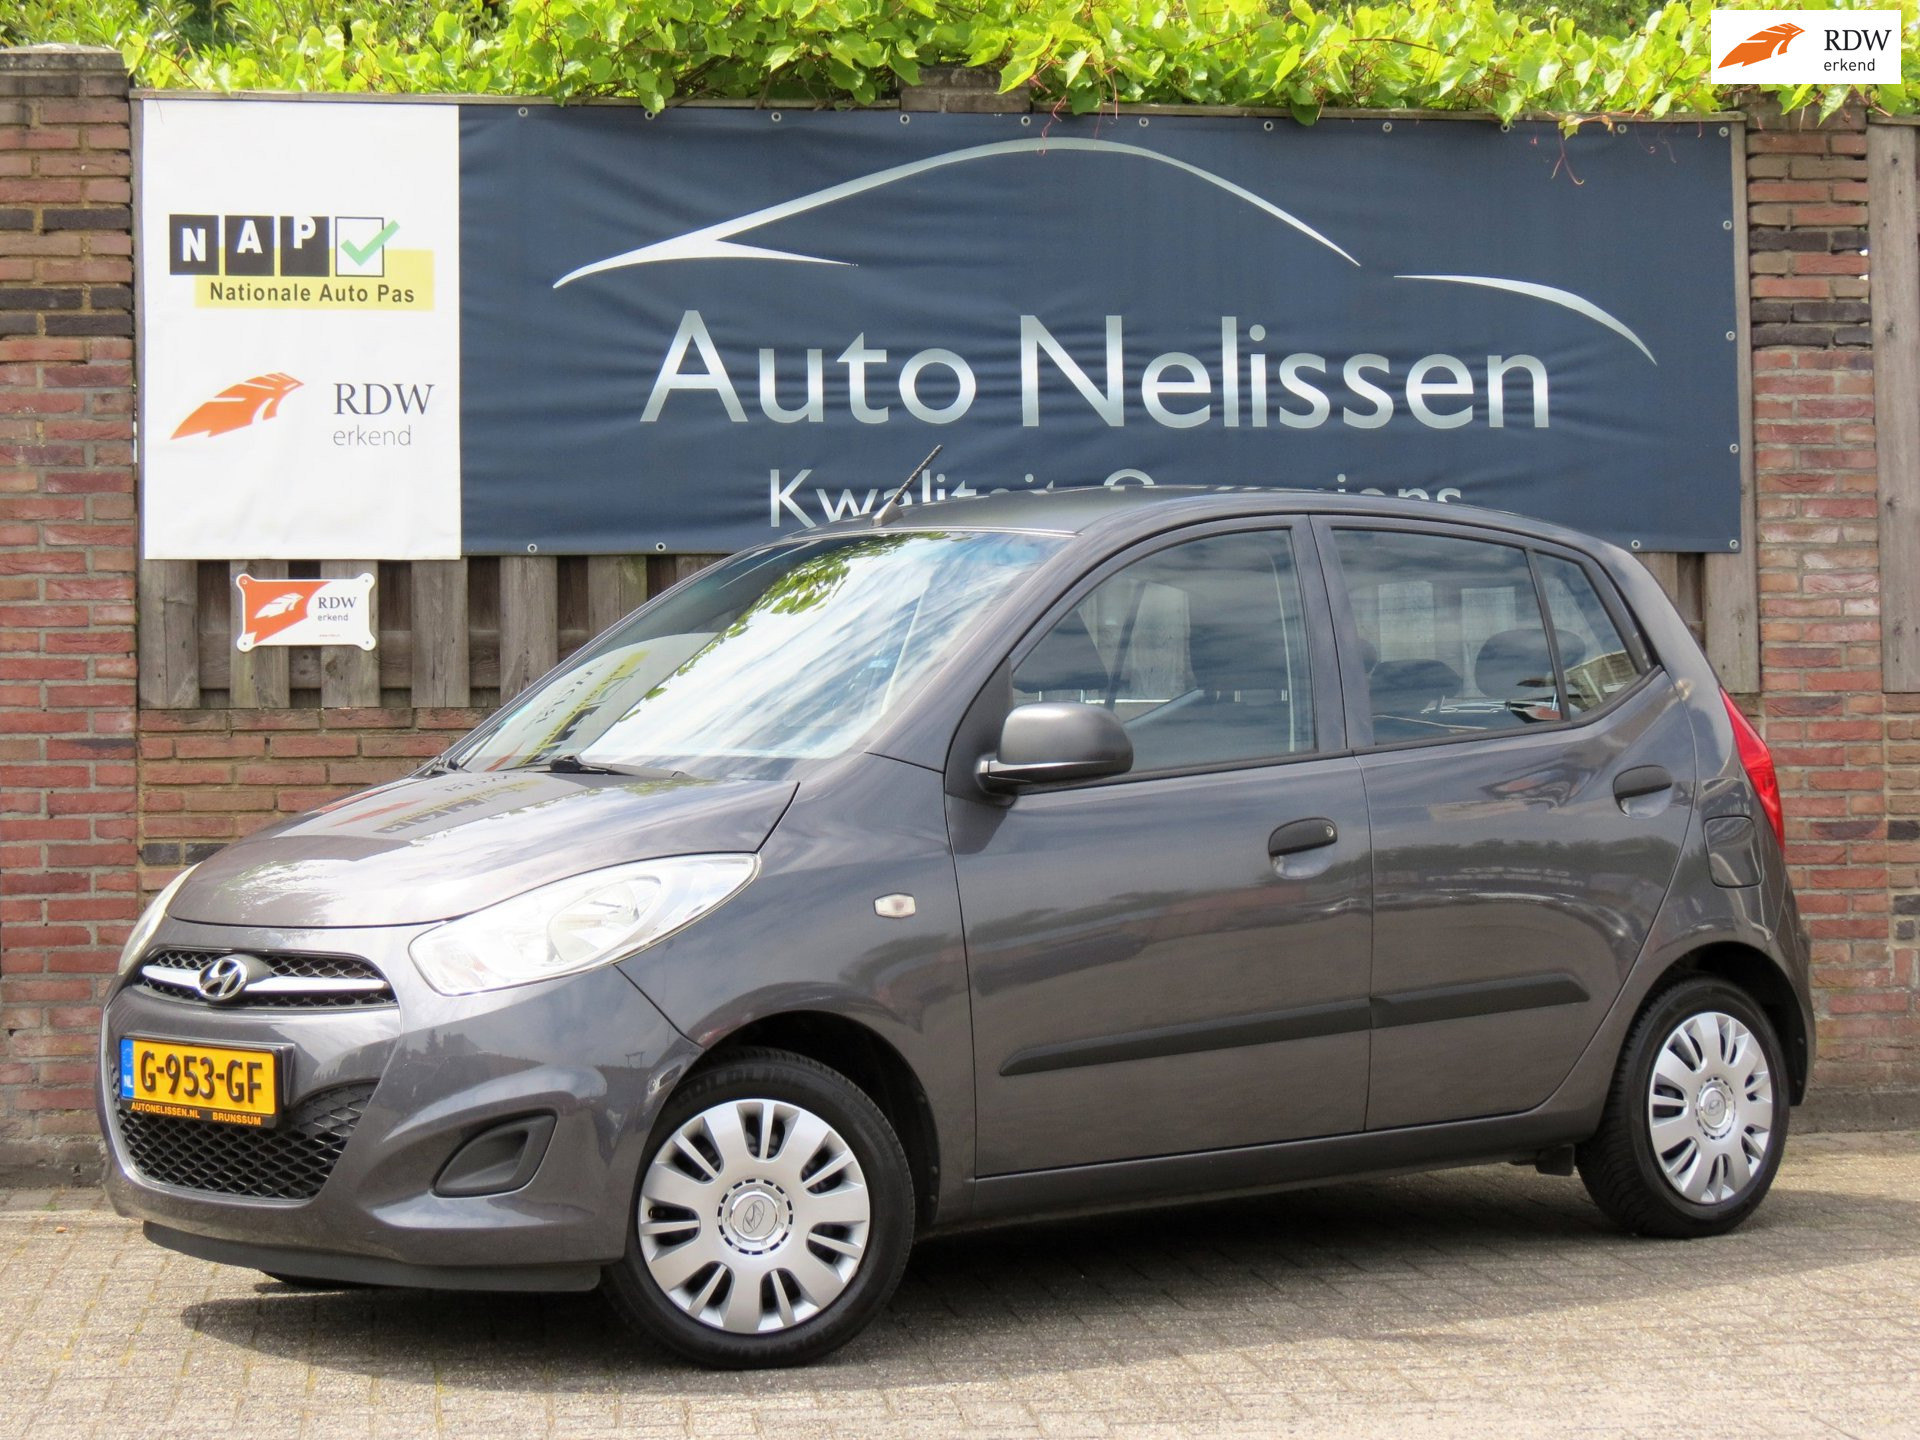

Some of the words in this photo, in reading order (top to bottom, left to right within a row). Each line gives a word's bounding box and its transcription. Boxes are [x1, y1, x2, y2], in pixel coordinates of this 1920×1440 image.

[182, 216, 316, 262] NAP
[210, 282, 311, 302] Nationale
[319, 284, 368, 302] Auto
[377, 284, 415, 303] Pas
[639, 309, 976, 426] Auto
[1020, 315, 1550, 429] Nelissen
[333, 383, 435, 415] RDW
[333, 425, 411, 446] erkend
[318, 596, 357, 609] RDW
[317, 612, 349, 621] erkend
[140, 1050, 263, 1104] G-953-GF
[131, 1102, 200, 1118] AUTONELISSEN.NL
[212, 1112, 262, 1125] BRUNSSUM
